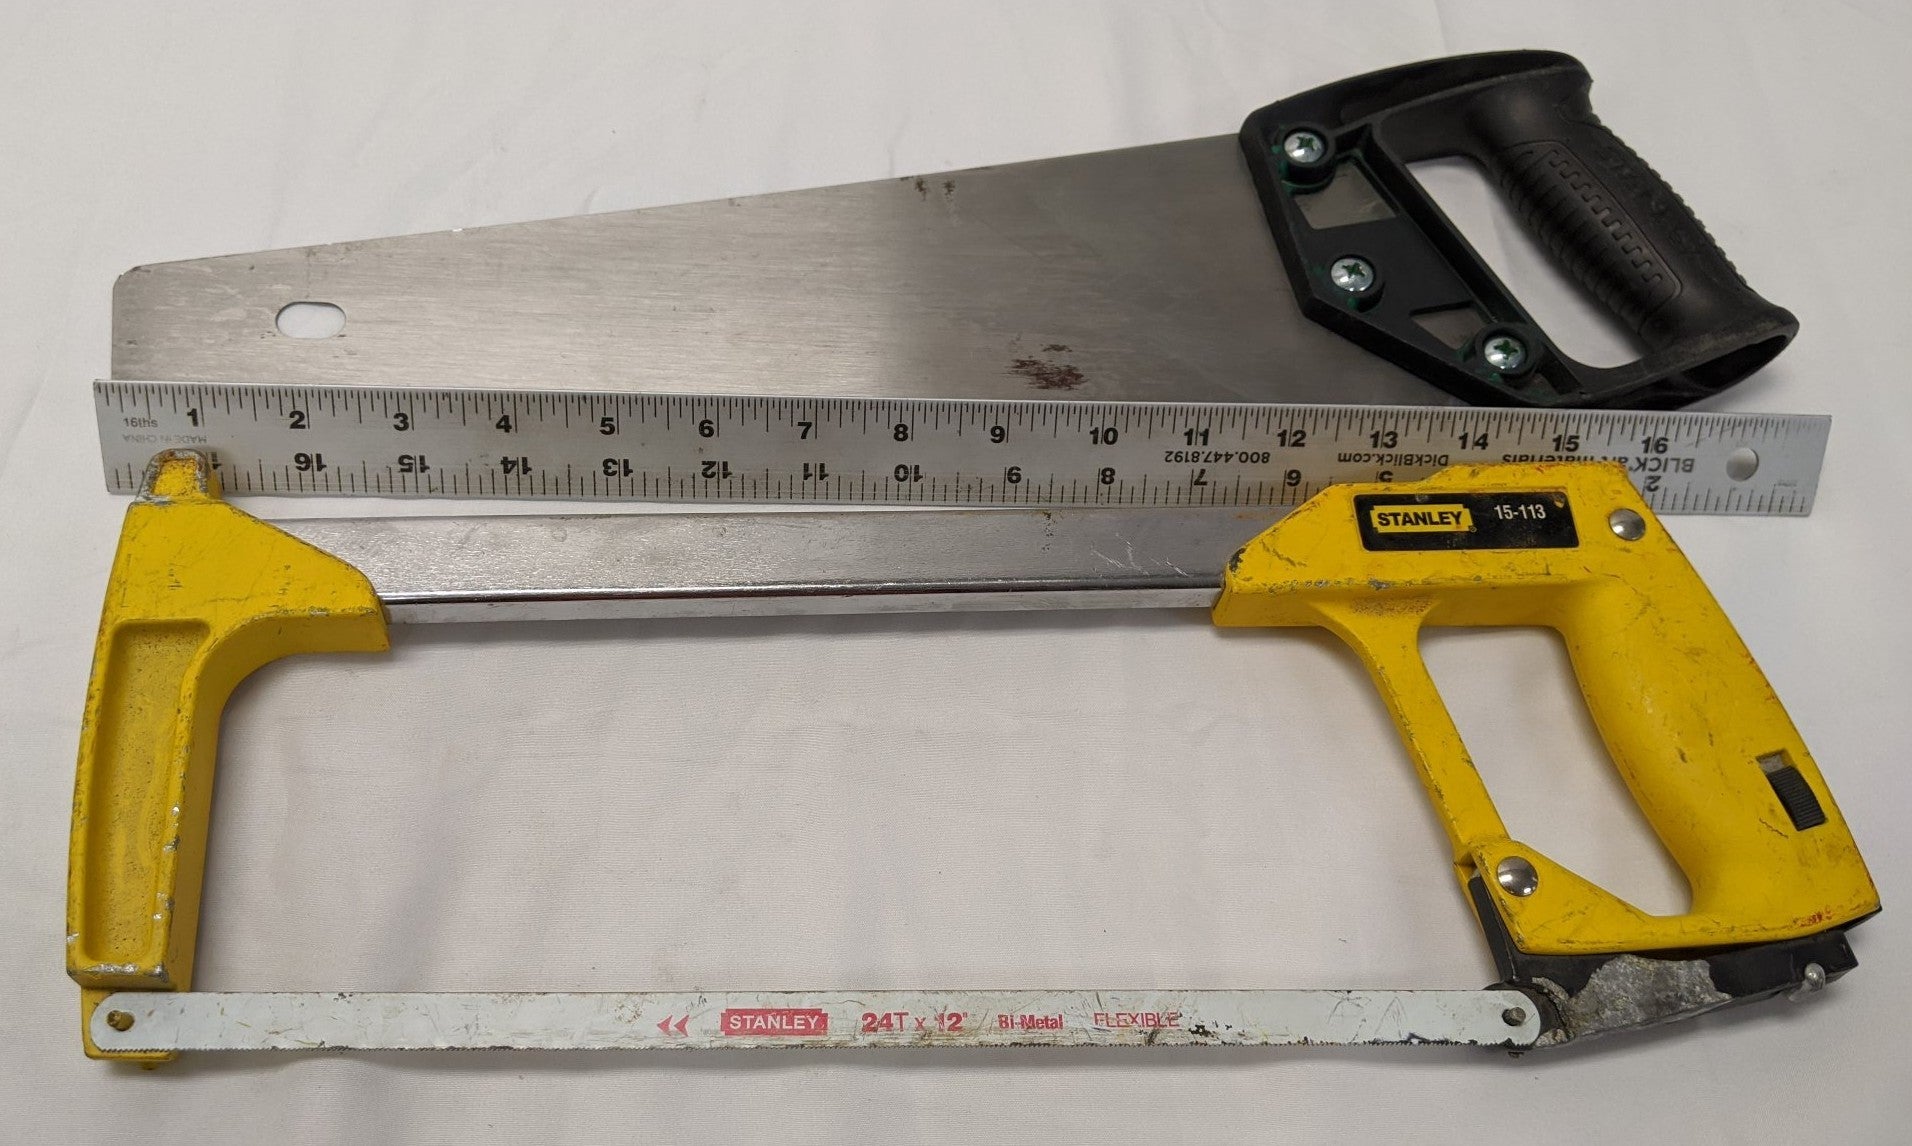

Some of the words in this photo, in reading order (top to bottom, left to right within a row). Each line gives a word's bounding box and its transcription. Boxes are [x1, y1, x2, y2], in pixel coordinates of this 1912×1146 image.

[123, 417, 158, 428] 16ths
[187, 408, 198, 427] 1
[289, 411, 306, 429] 2
[393, 412, 410, 431] 3
[496, 414, 512, 433] 4
[600, 417, 615, 435] 5
[698, 419, 714, 438] 6
[797, 421, 812, 439] 7
[893, 423, 909, 441] 8
[990, 425, 1005, 443] 9
[1090, 427, 1118, 445] 10
[1184, 428, 1209, 446] 11
[1277, 429, 1307, 447] 12
[1370, 431, 1398, 449] 13
[1458, 433, 1489, 450] 14
[1552, 434, 1580, 452] 15
[1642, 437, 1668, 454] 16
[294, 452, 327, 471] 16
[397, 454, 430, 473] 15
[500, 456, 532, 475] 14
[1165, 451, 1270, 464] 800.447.8192
[1337, 453, 1449, 467] DickBlick.com
[603, 458, 634, 477] 13
[701, 460, 733, 479] 12
[803, 462, 829, 480] 11
[894, 464, 923, 482] 10
[1007, 466, 1022, 483] 9
[1101, 467, 1115, 485] 8
[1194, 468, 1208, 486] 7
[1286, 469, 1301, 486] 6
[1377, 511, 1463, 527] STANLEY
[1494, 504, 1546, 520] 15-113
[729, 1014, 819, 1030] STANLEY
[861, 1012, 909, 1033] 24T
[997, 1013, 1063, 1030] Bi-Metal
[1093, 1011, 1180, 1028] FLEXIBLE
